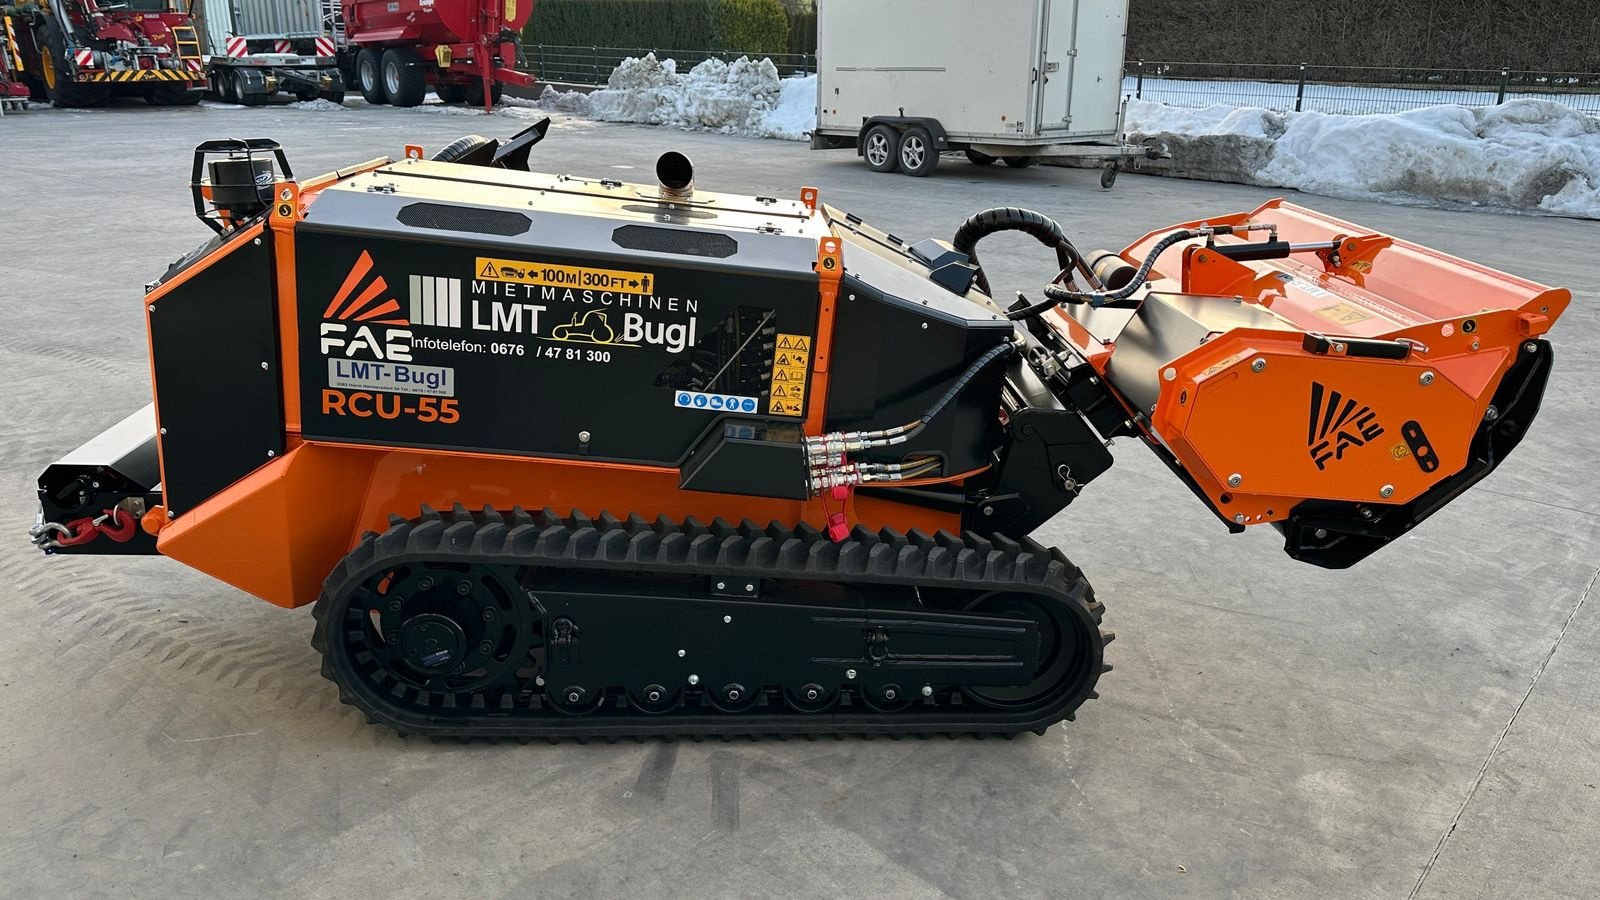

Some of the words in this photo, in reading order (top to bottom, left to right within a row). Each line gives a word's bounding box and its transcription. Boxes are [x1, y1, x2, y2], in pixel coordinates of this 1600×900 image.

[471, 280, 698, 313] MIETMASCHINEN
[320, 322, 413, 362] FAE
[472, 300, 547, 334] LMT
[623, 312, 697, 353] Bugl
[410, 336, 486, 354] Infotelefon:
[490, 342, 525, 356] 0676
[536, 346, 542, 358] /
[544, 347, 562, 359] 47
[565, 348, 582, 361] 81
[586, 350, 611, 363] 300
[322, 388, 460, 424] RCU-55
[1310, 412, 1384, 471] FAE
